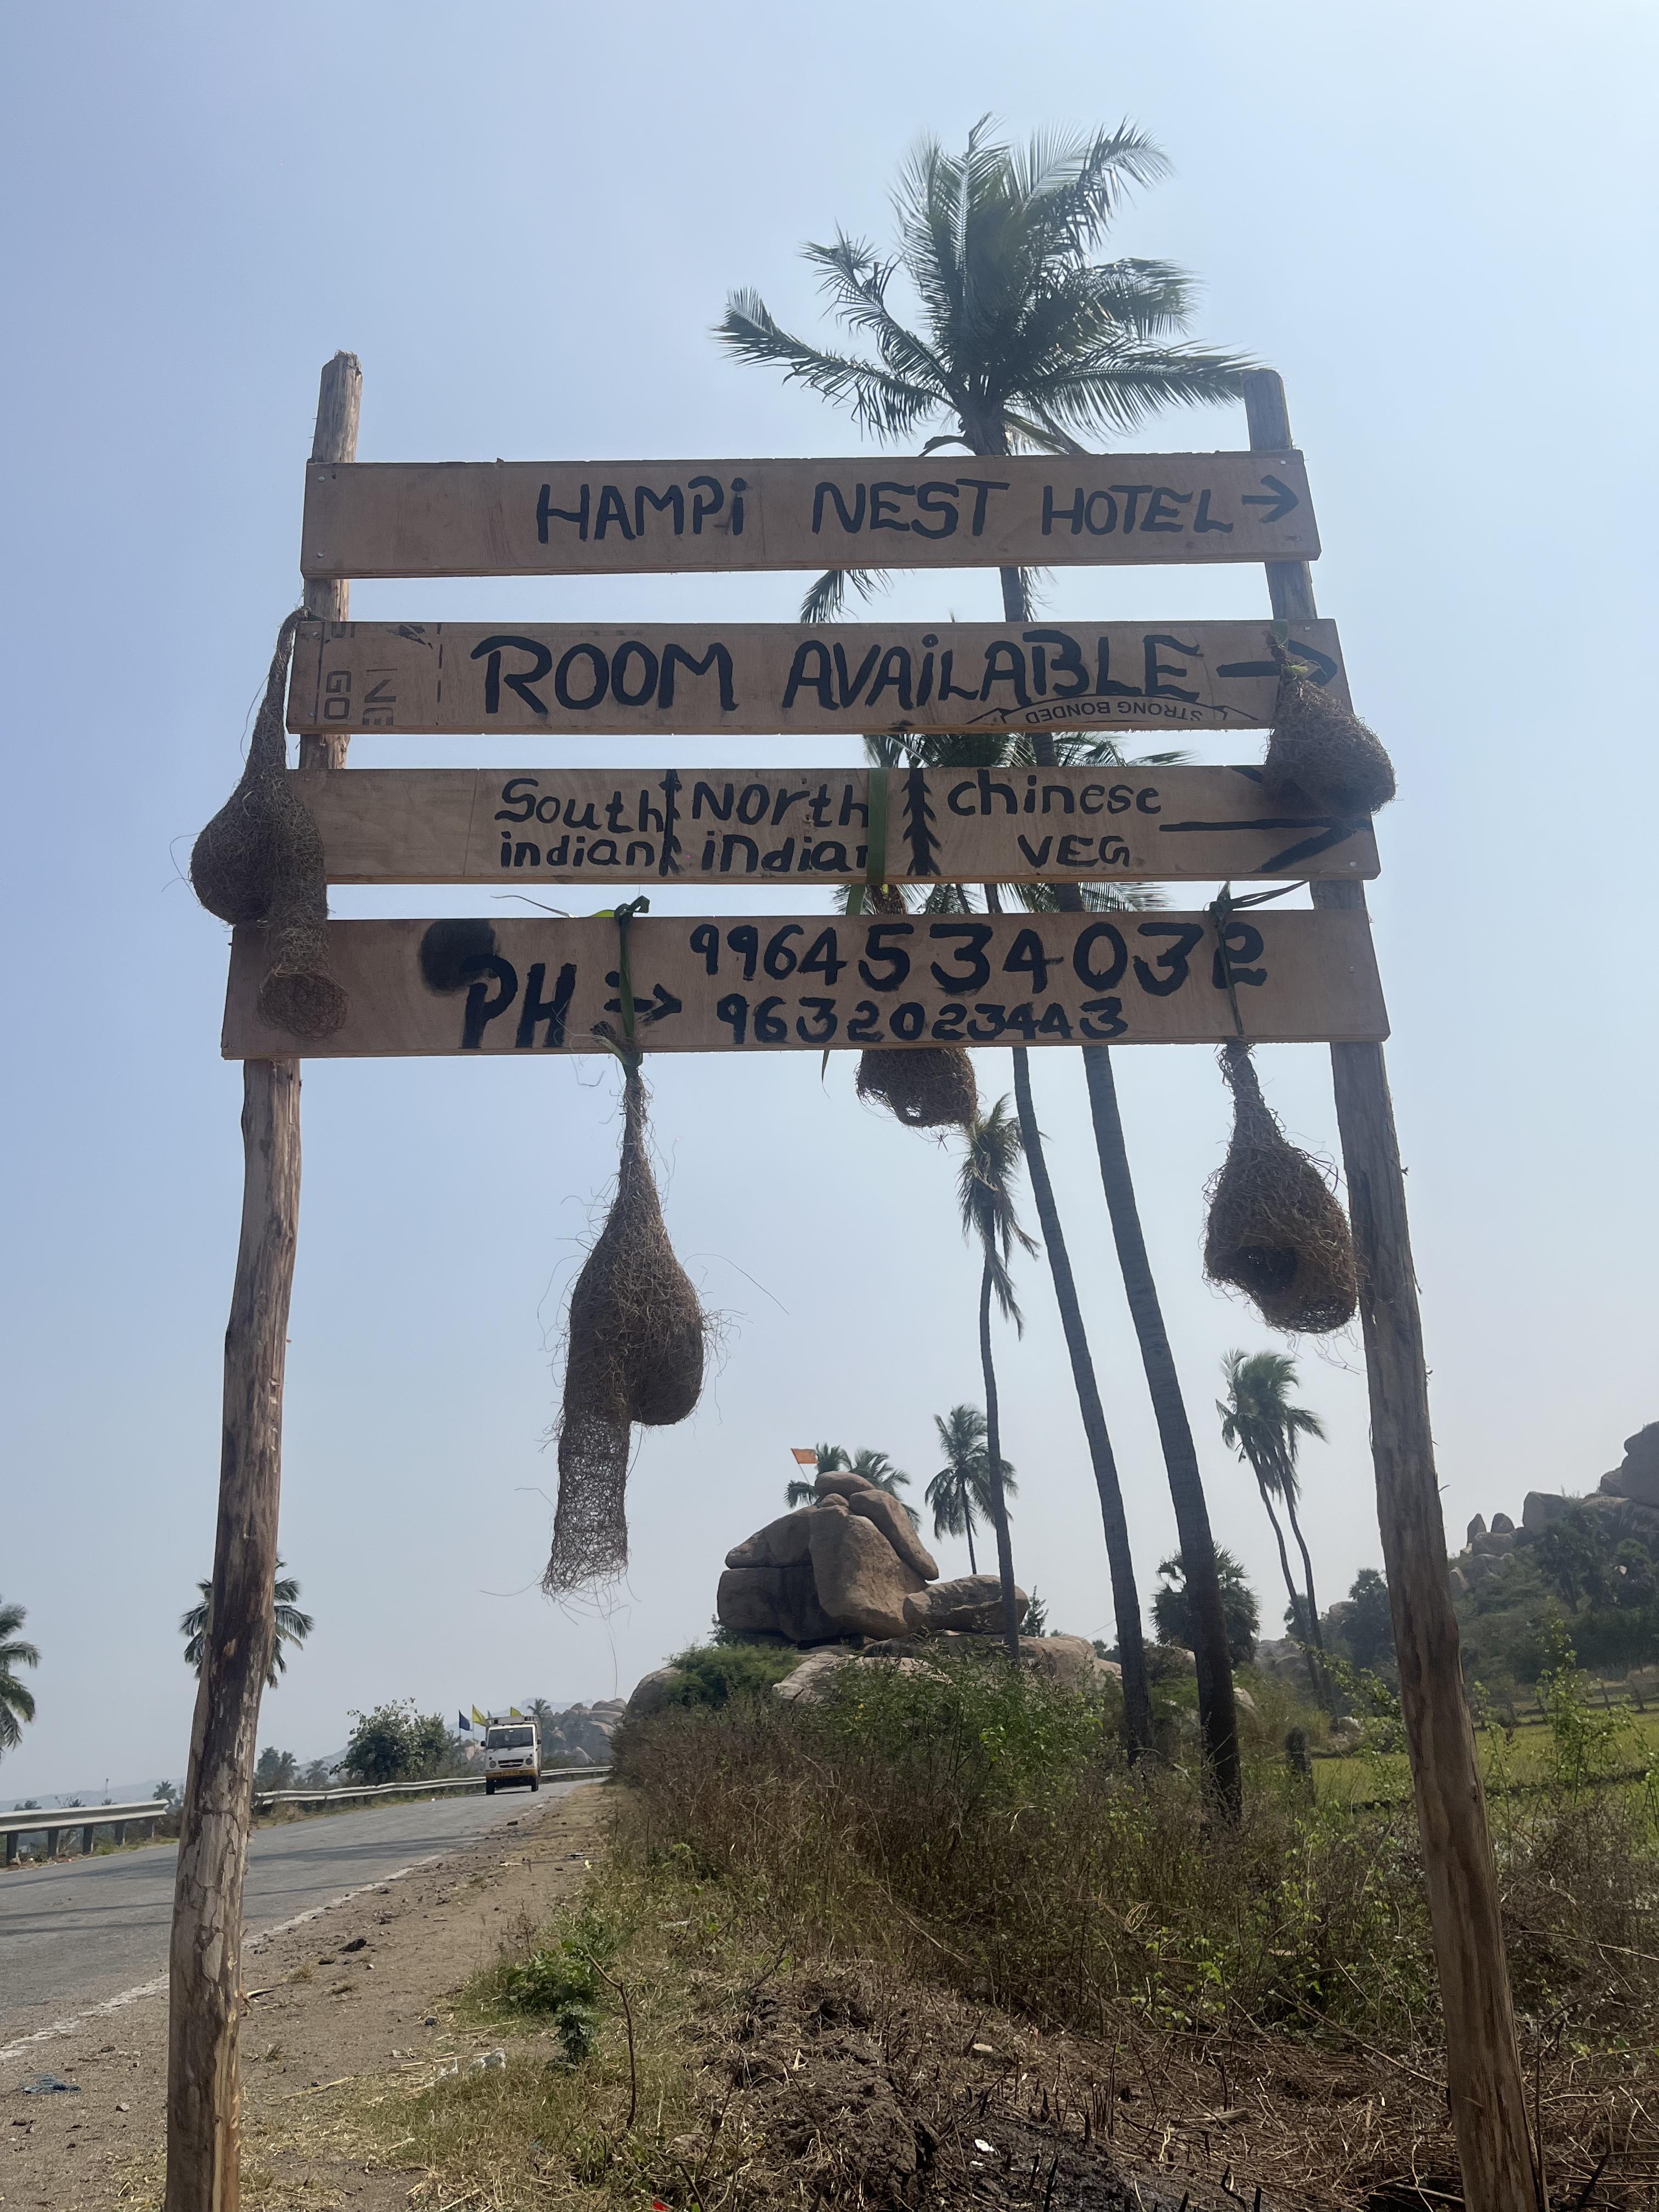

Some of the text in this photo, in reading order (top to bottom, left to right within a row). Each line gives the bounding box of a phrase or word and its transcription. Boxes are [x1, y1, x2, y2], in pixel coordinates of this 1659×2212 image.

[811, 478, 1011, 540] NEST
[1041, 484, 1234, 536] HOTEL
[470, 635, 740, 715] ROOM
[1025, 701, 1203, 724] STRONG BONDED
[494, 777, 663, 833] South
[500, 831, 655, 867] indian
[1017, 833, 1130, 869] VEG
